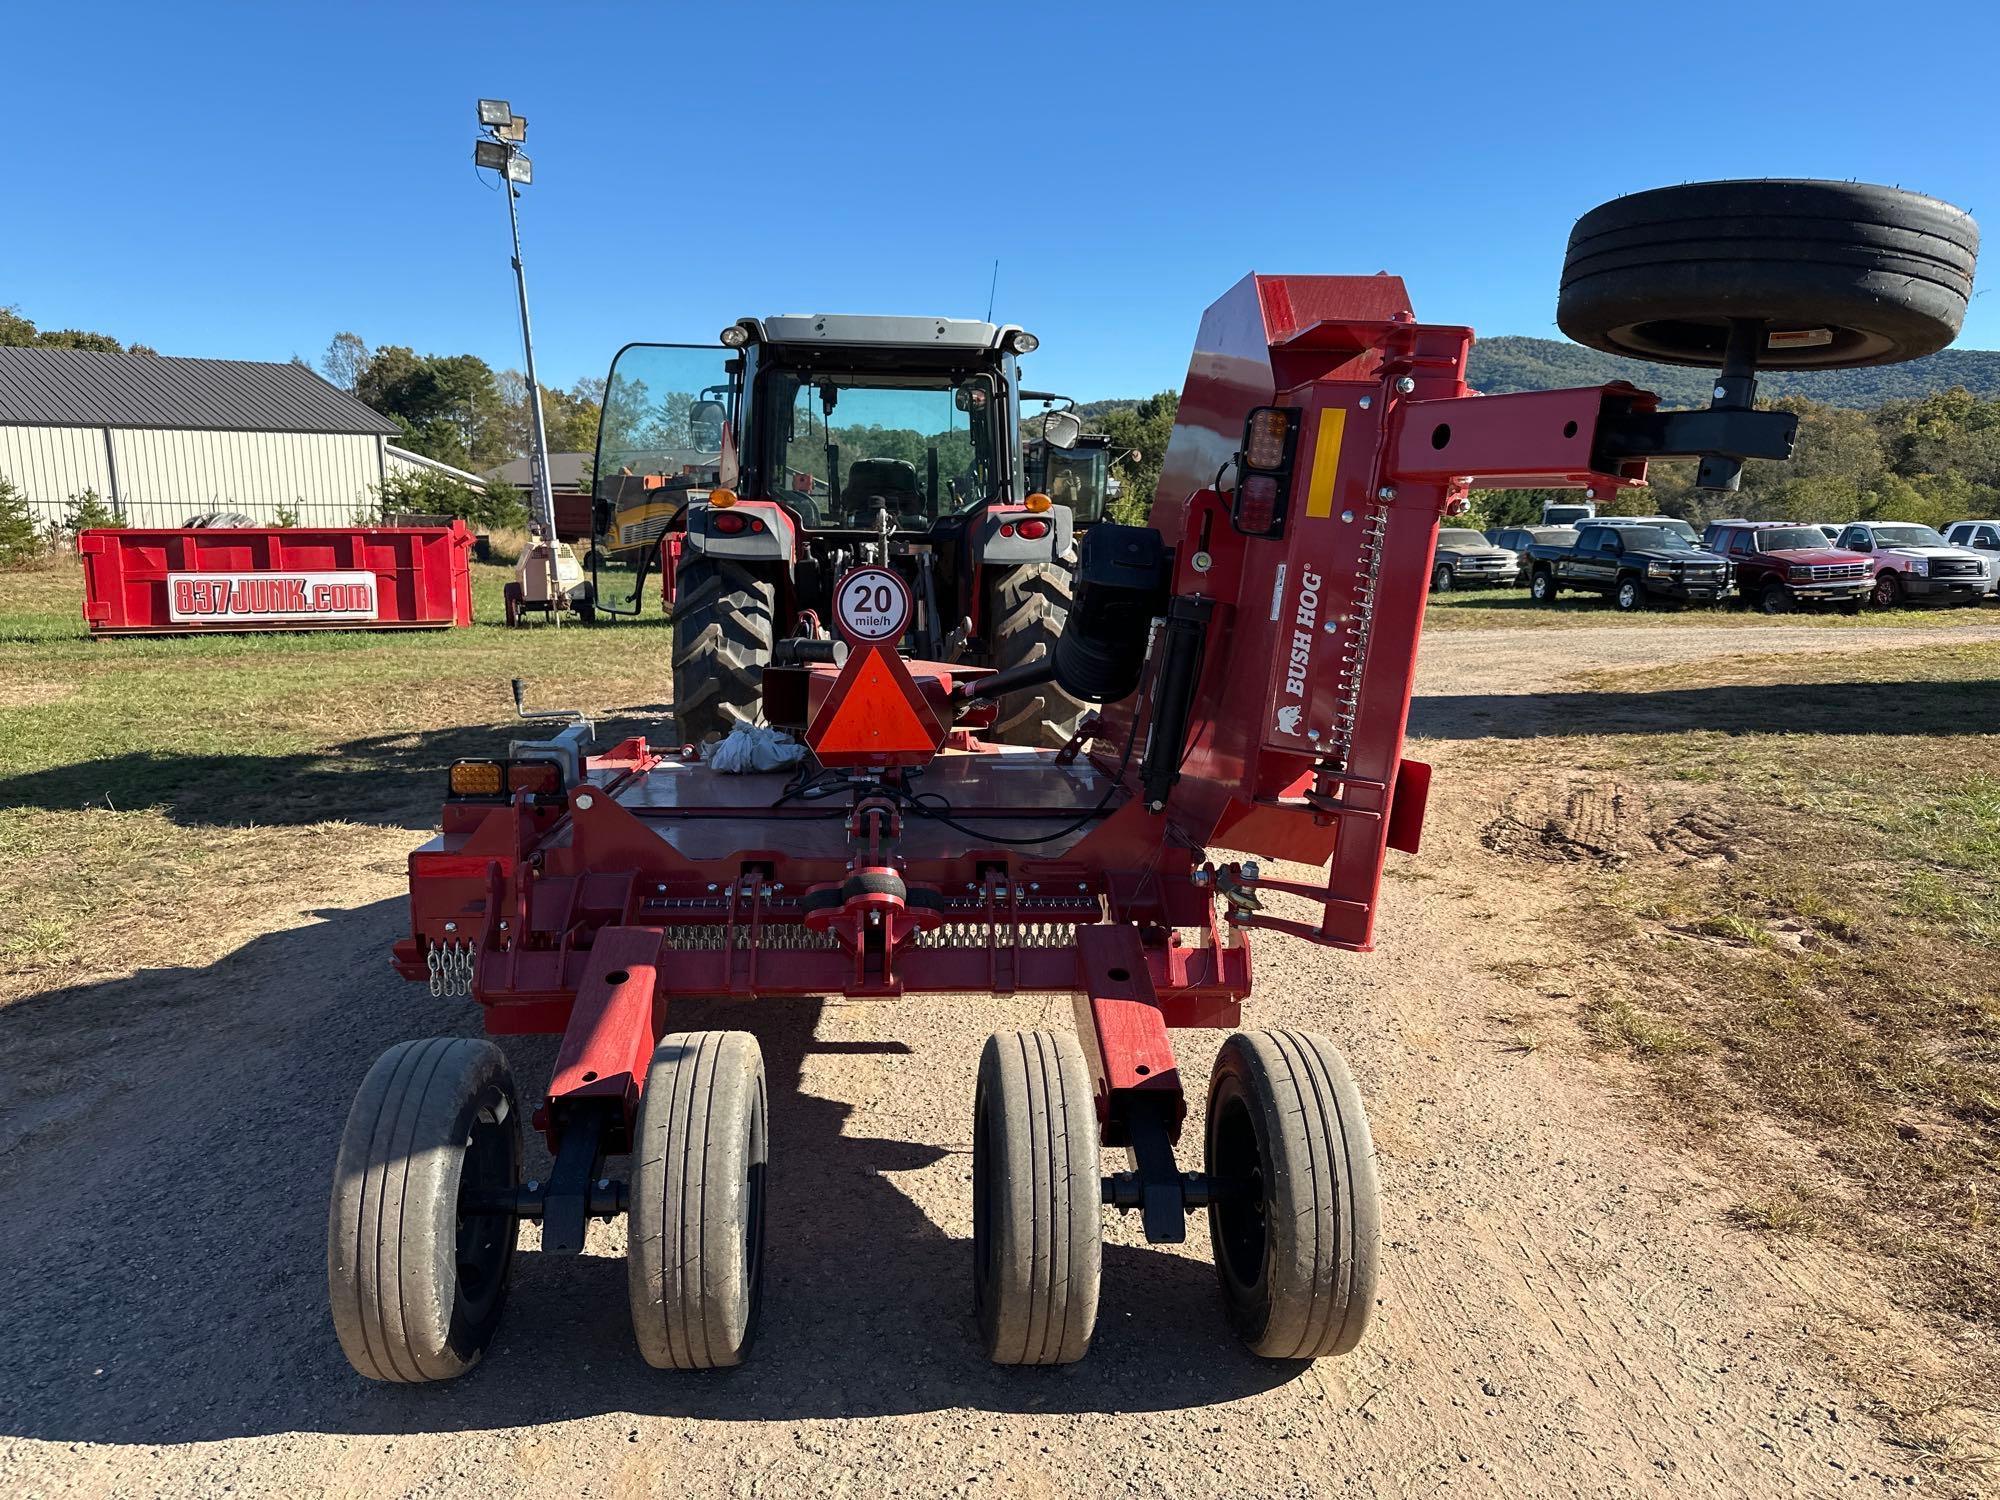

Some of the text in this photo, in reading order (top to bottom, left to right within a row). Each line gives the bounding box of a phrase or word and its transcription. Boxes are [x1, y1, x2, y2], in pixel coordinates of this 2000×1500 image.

[174, 579, 373, 614] 837JUNK.com
[853, 585, 892, 613] 20
[855, 615, 891, 626] mile/h
[1285, 629, 1313, 698] BUSH
